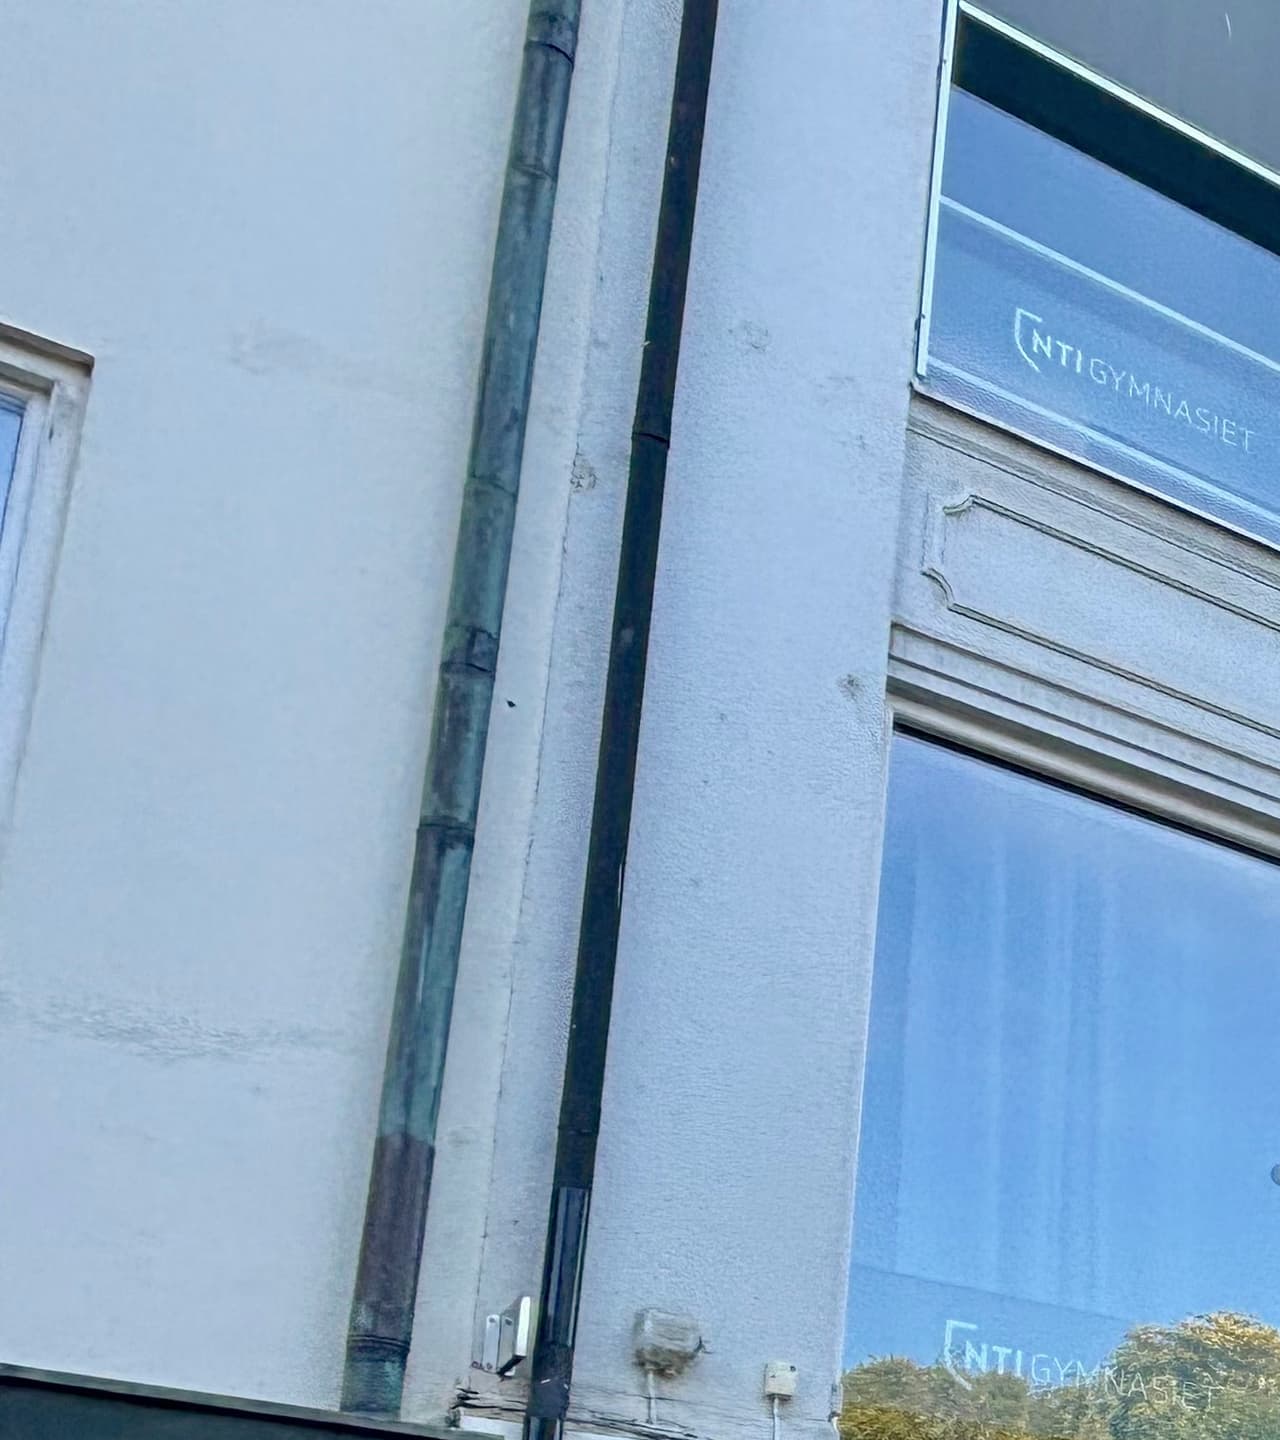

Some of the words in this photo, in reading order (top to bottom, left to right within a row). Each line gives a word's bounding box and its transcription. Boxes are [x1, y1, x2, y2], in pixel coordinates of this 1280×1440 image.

[1032, 329, 1083, 374] NTI
[1089, 356, 1256, 454] GYMNASIET
[962, 1340, 1023, 1376] NTI
